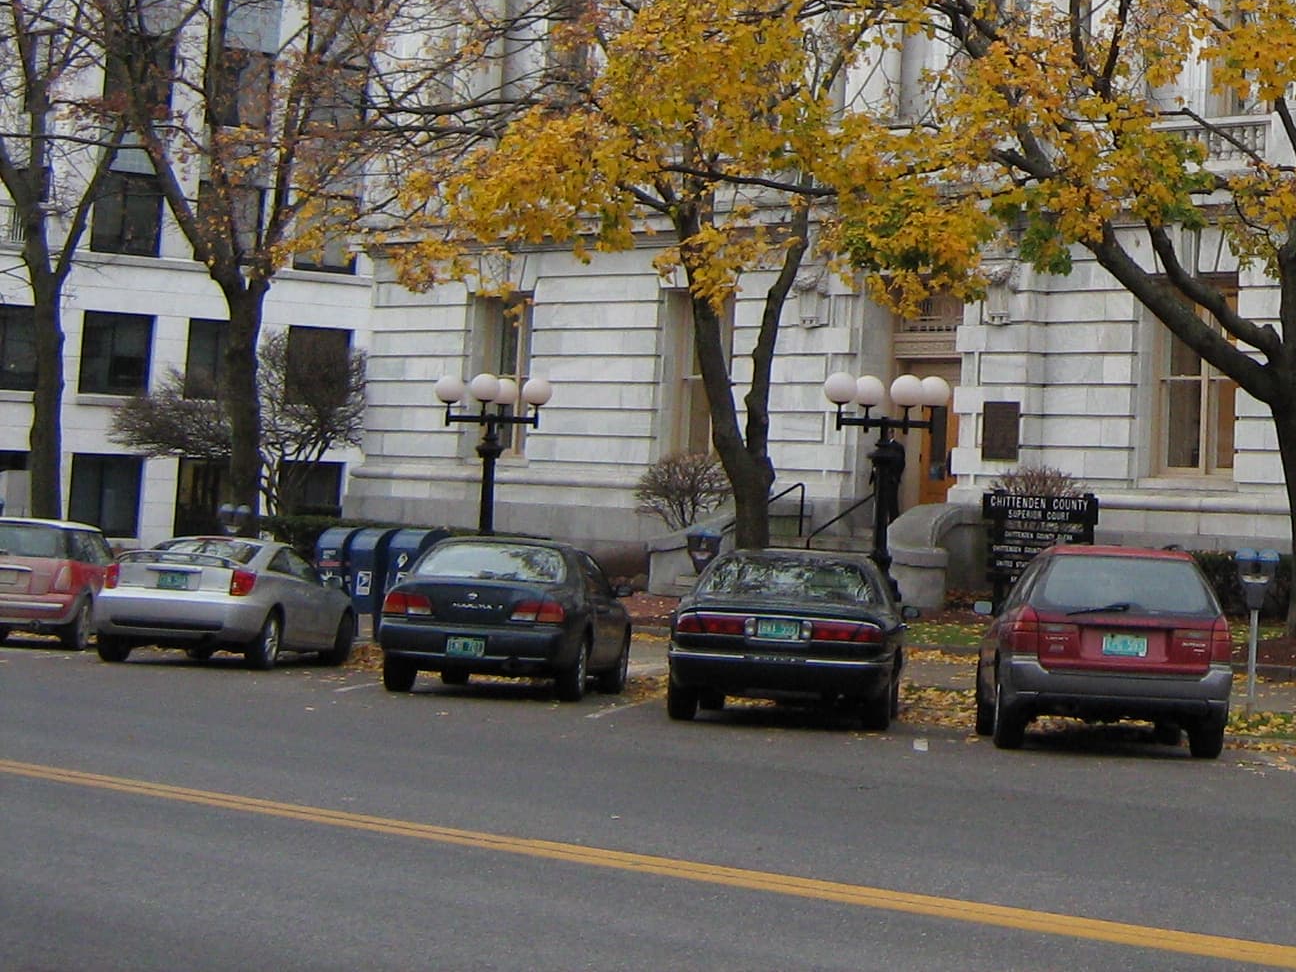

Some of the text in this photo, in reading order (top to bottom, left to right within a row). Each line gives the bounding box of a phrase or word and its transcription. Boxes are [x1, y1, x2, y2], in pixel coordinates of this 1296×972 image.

[990, 495, 1089, 511] CHITTENDEN COUNTY
[1008, 509, 1070, 521] SUPERIOR COURT
